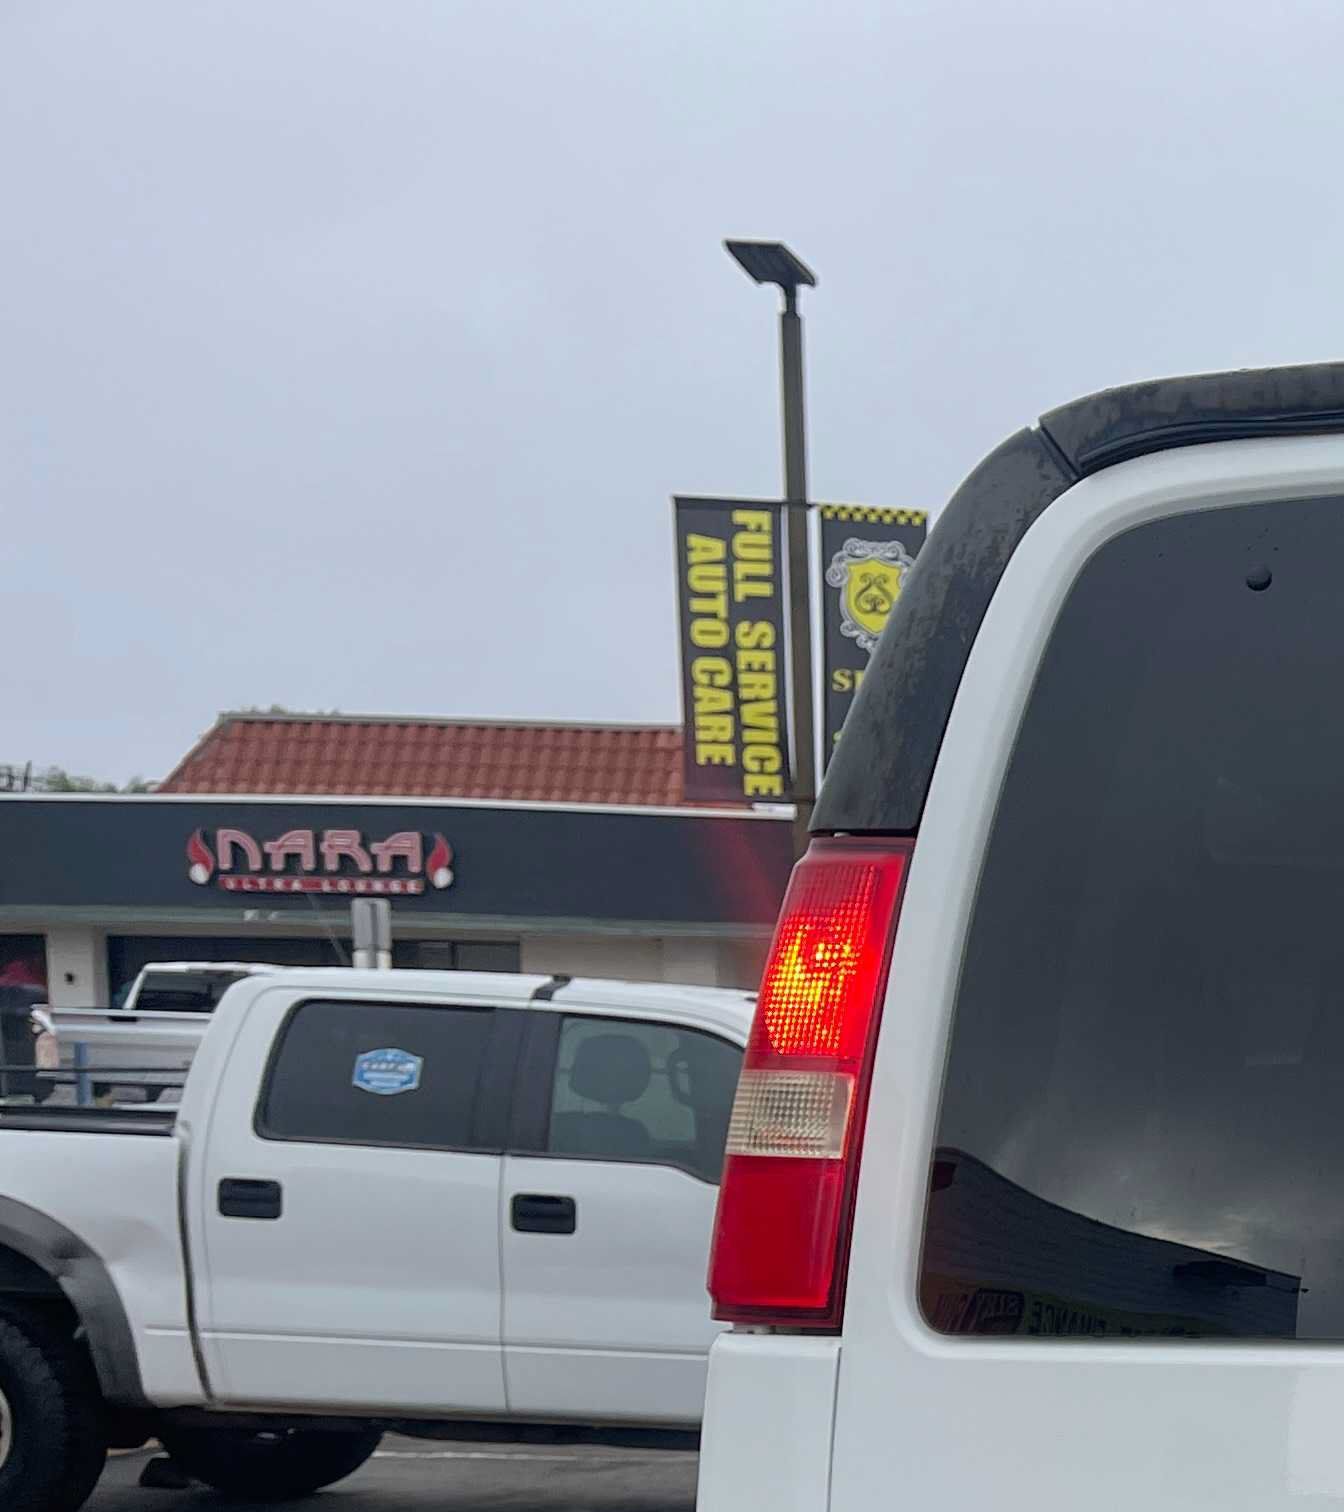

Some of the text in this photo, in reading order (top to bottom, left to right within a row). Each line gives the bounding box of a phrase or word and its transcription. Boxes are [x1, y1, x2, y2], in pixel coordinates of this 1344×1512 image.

[686, 533, 737, 767] AUTO CARE
[732, 509, 785, 797] FULL SERVICE
[215, 828, 424, 874] NARA
